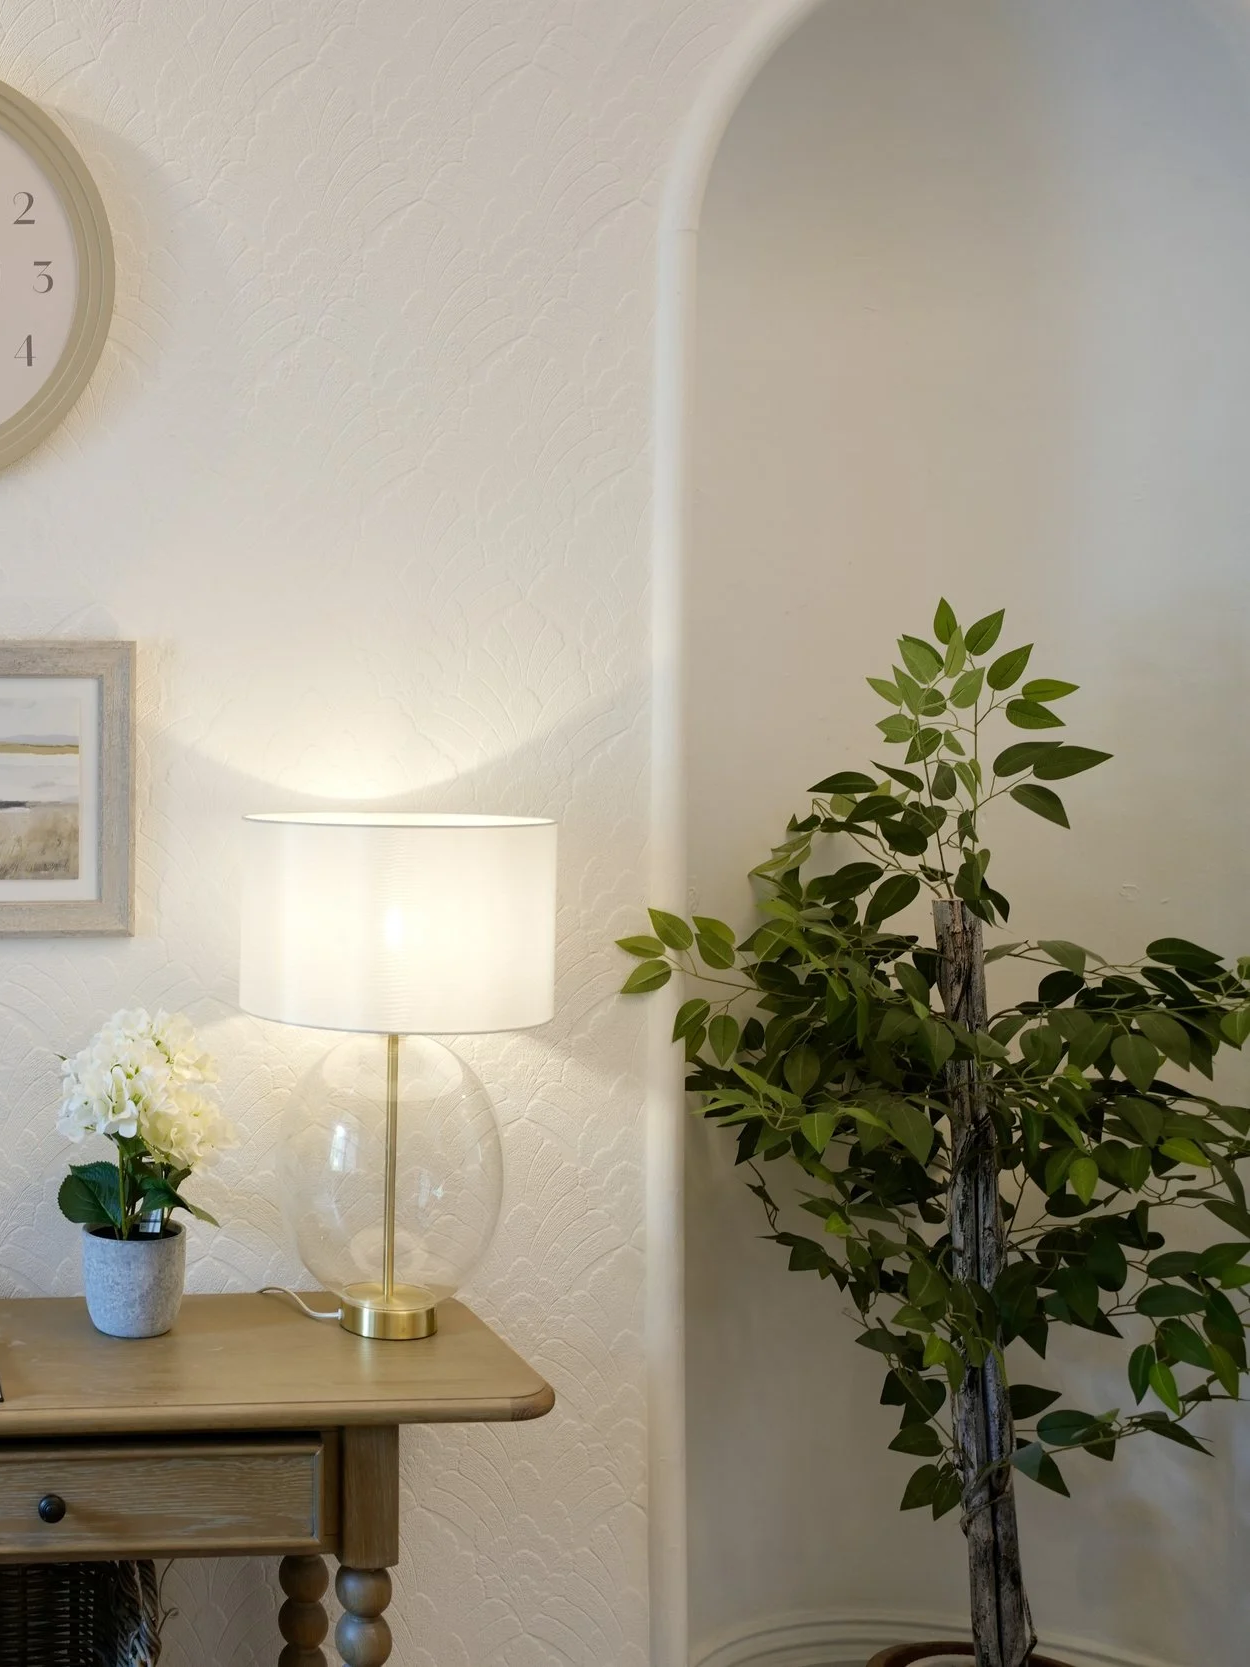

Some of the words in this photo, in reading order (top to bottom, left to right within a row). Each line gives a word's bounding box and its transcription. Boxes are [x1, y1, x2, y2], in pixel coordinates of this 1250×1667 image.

[13, 191, 36, 225] 2
[32, 261, 54, 294] 3
[13, 334, 37, 367] 4
